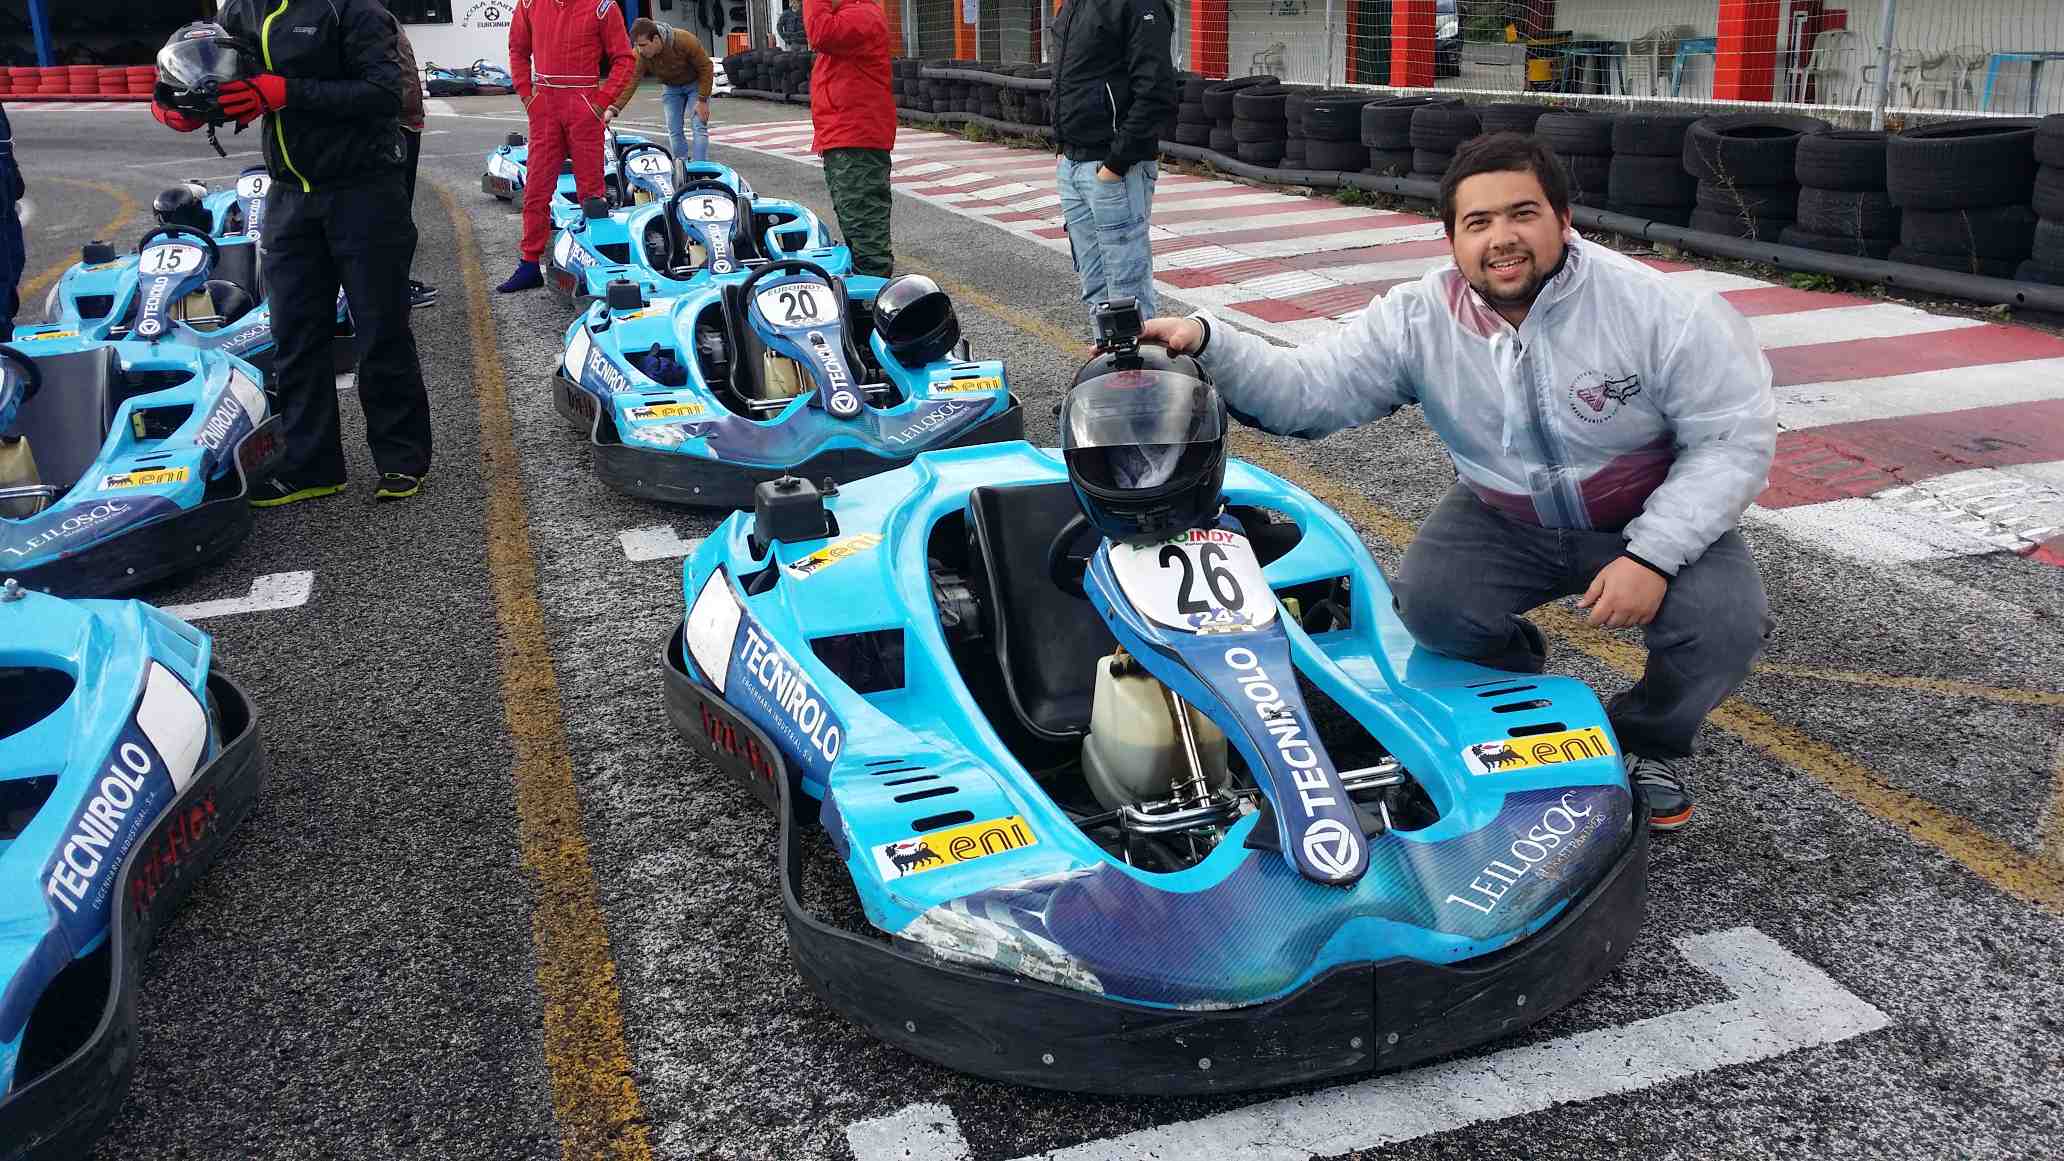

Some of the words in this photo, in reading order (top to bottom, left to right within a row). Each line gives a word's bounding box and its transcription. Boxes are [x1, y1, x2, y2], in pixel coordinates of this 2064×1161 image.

[641, 157, 660, 171] 21
[252, 178, 263, 194] 9
[703, 199, 715, 217] 5
[155, 249, 183, 269] 15
[779, 289, 818, 321] 20
[961, 377, 1001, 392] eni
[888, 398, 964, 445] LEILOSOC
[5, 497, 129, 557] LEILOSOC
[1159, 543, 1244, 615] 26
[738, 627, 840, 762] TECNIROLO
[1224, 647, 1337, 817] TECNIROLO
[1532, 735, 1608, 765] eni
[47, 742, 152, 913] TECNIROLO
[949, 824, 1029, 863] eni
[1446, 792, 1593, 915] LEILOSOC
